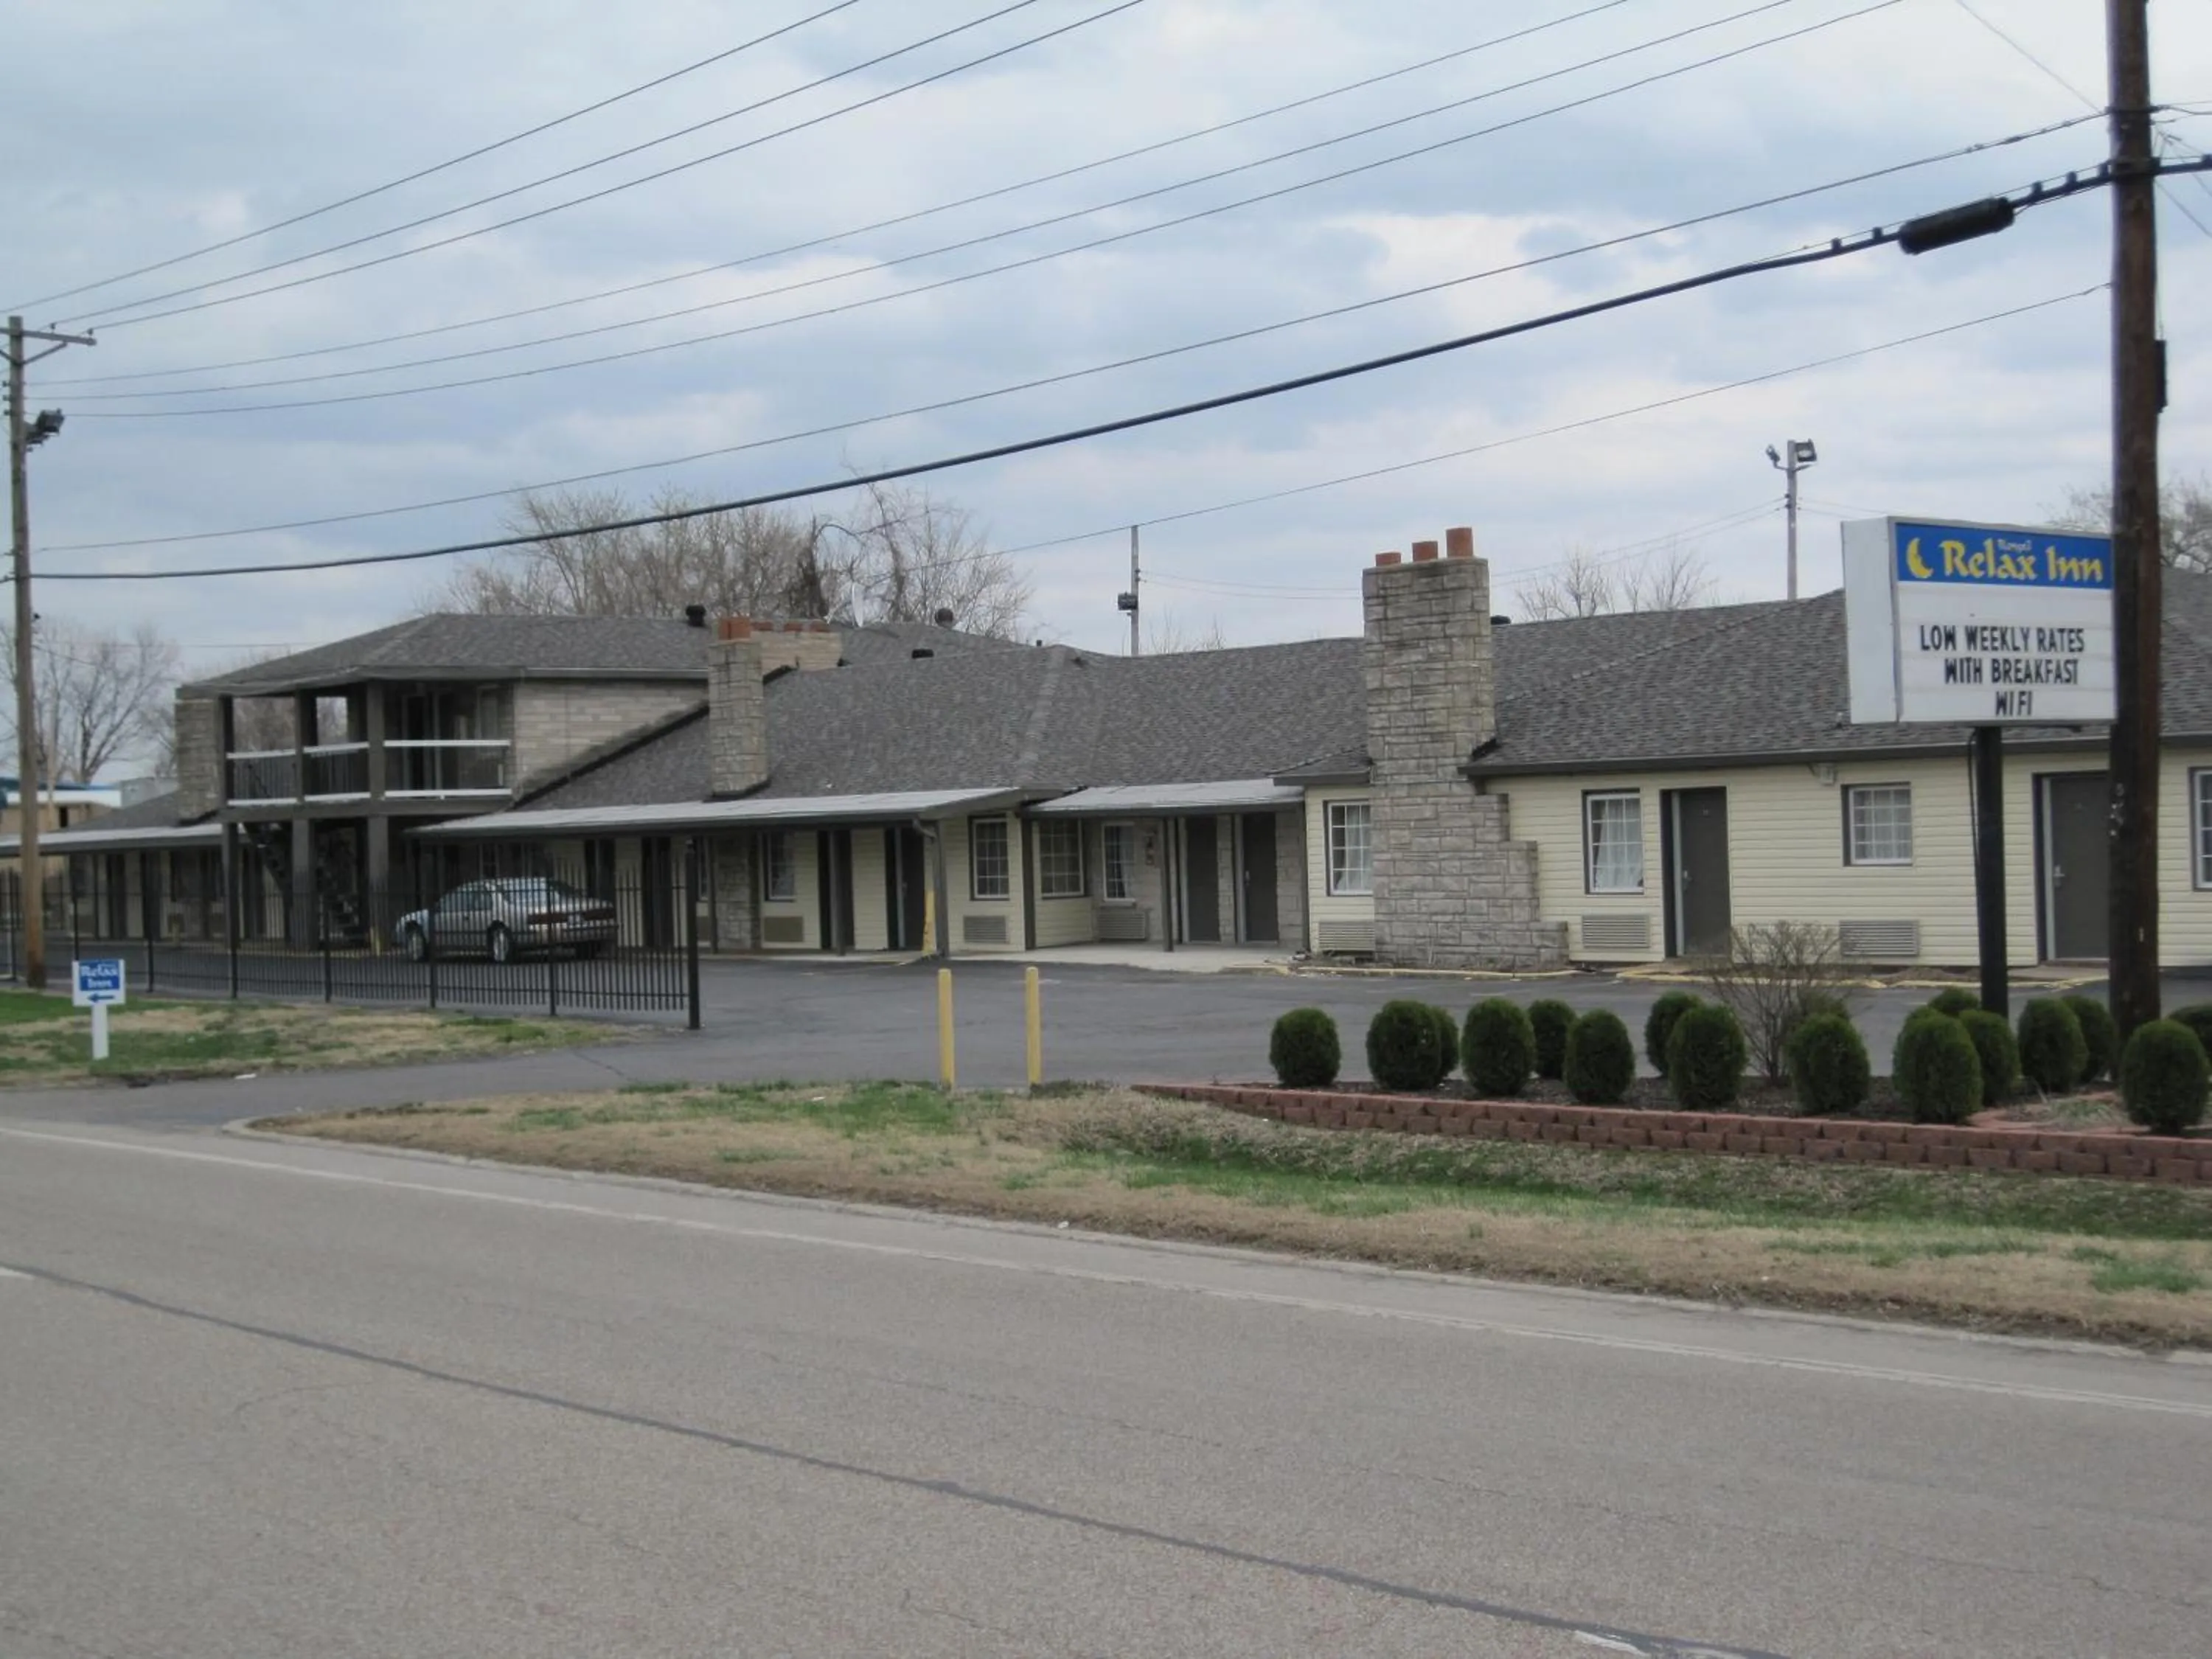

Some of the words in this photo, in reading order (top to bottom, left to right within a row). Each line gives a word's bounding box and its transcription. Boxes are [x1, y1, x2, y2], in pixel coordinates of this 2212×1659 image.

[1939, 538, 2037, 580] Relax
[2045, 545, 2103, 582] Inn
[1920, 625, 1956, 651] LOW
[1964, 626, 2031, 652] WEEKLY
[2037, 627, 2085, 653] RATES
[1944, 657, 1983, 684] WITH
[1991, 658, 2079, 684] BREAKFAST
